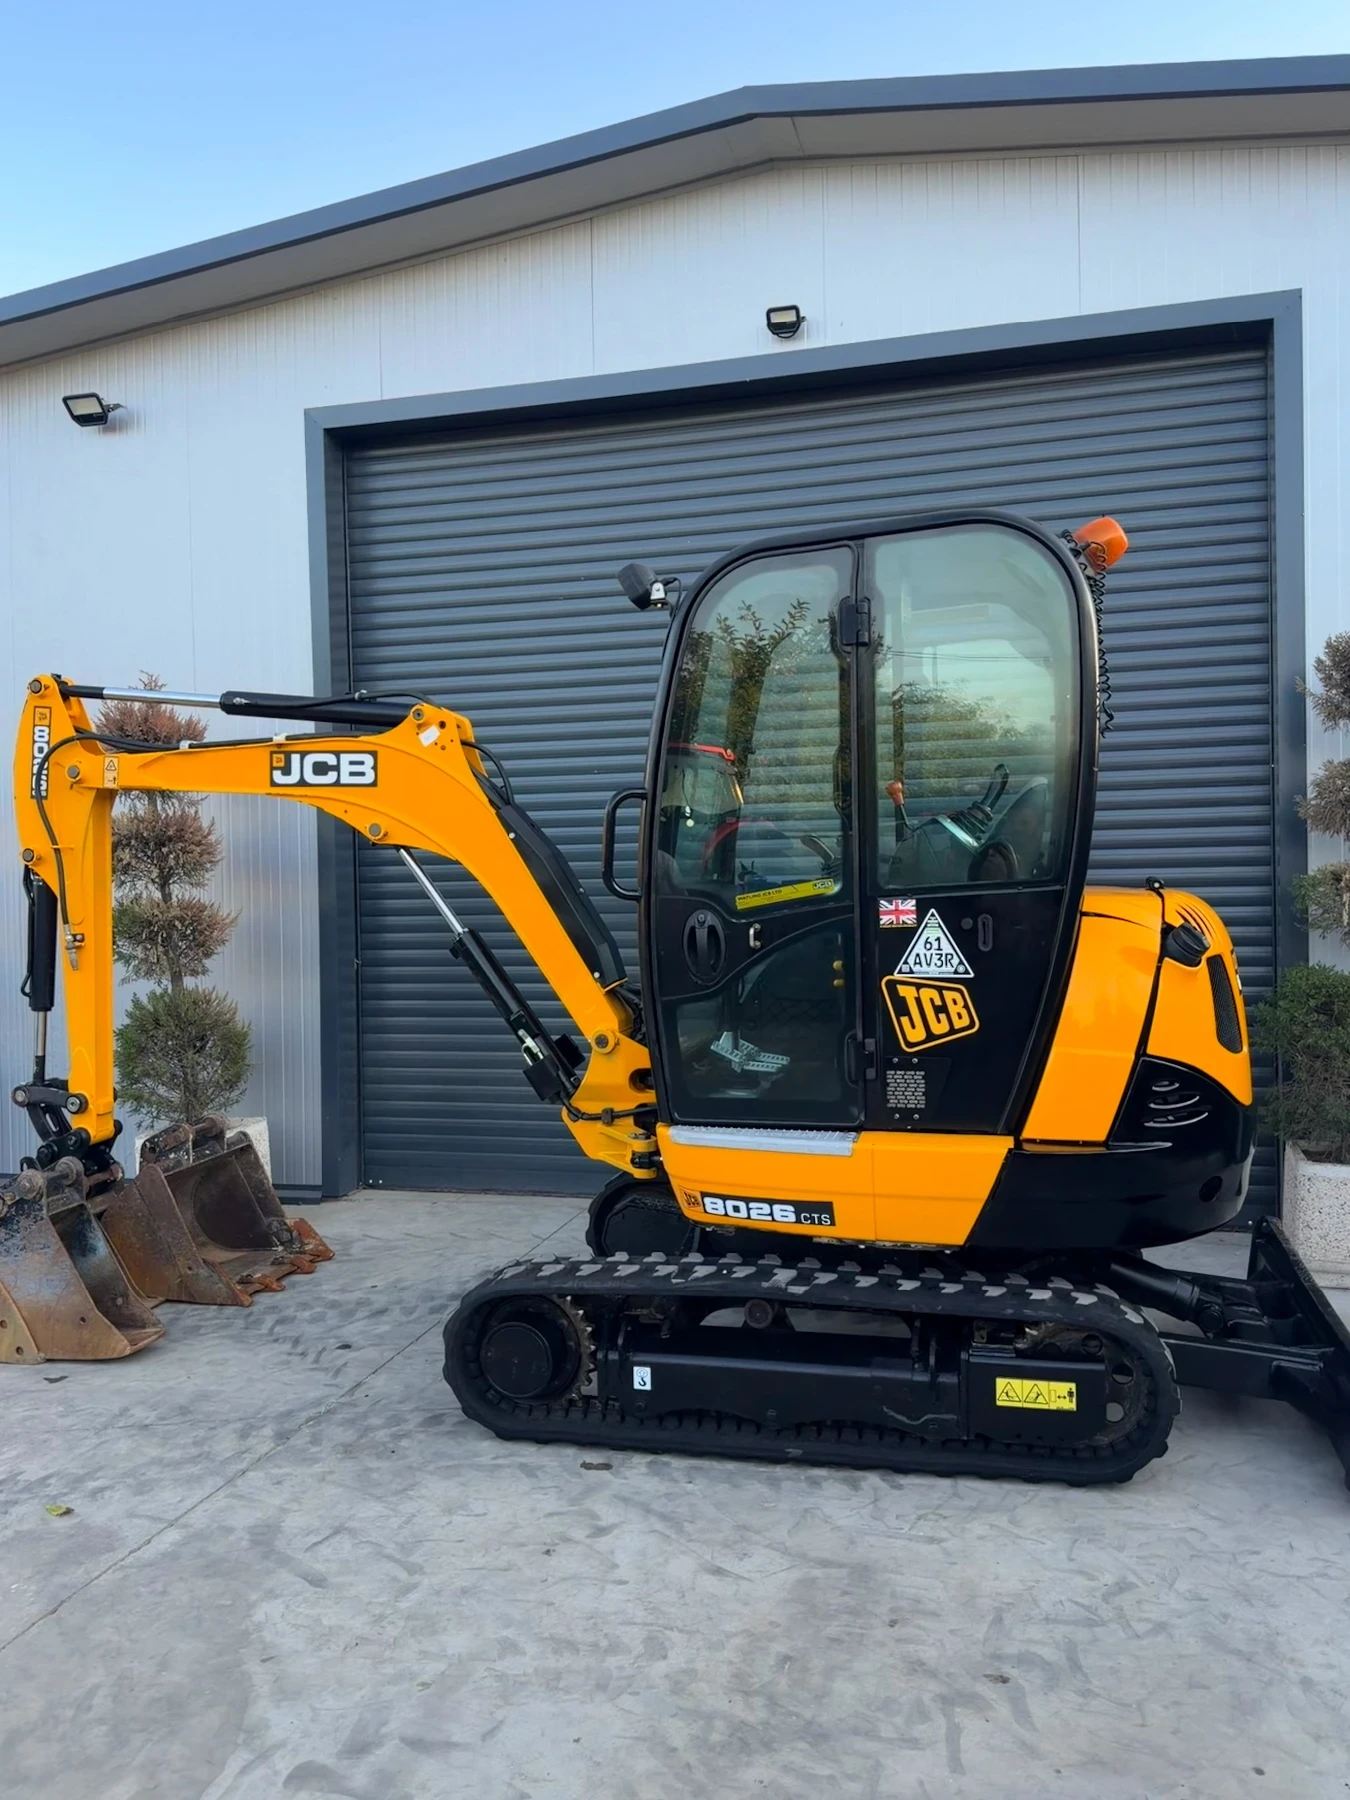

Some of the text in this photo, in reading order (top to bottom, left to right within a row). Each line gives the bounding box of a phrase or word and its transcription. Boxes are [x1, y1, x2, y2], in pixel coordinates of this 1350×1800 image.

[272, 753, 376, 785] JCB
[923, 936, 943, 951] 61
[913, 953, 954, 968] AV3R
[896, 984, 970, 1043] JCB
[703, 1196, 831, 1225] 8026 CTS
